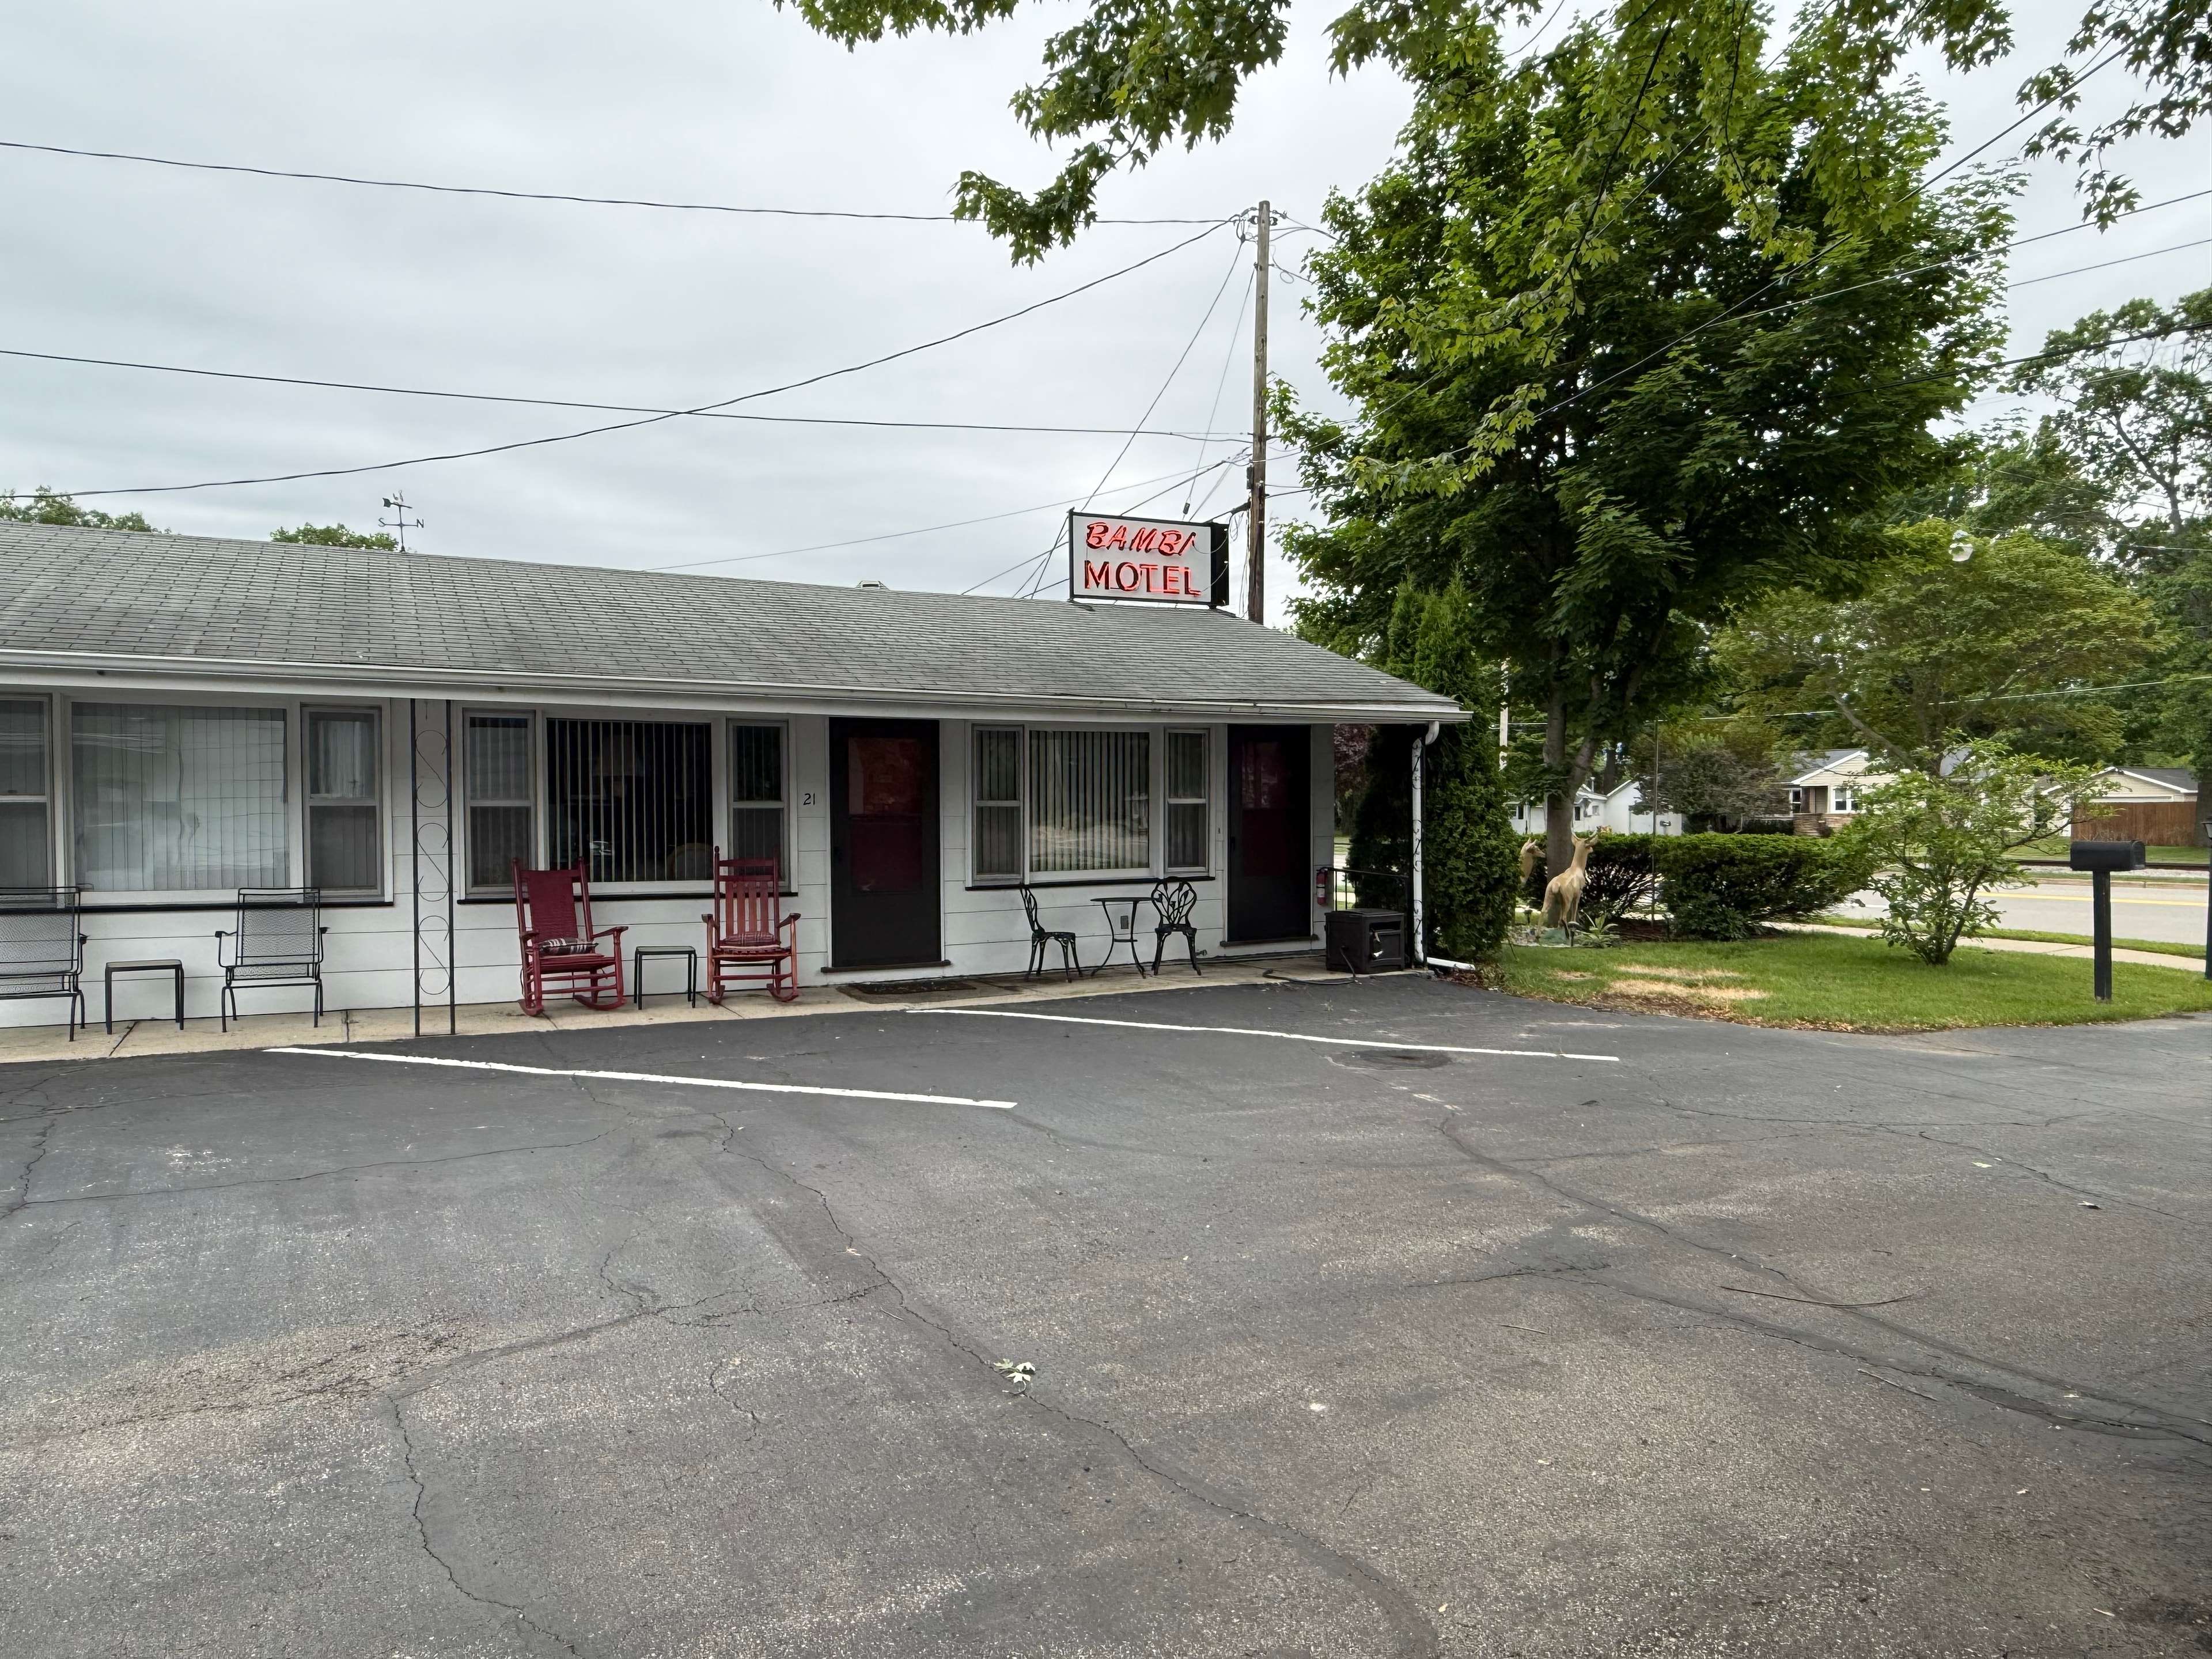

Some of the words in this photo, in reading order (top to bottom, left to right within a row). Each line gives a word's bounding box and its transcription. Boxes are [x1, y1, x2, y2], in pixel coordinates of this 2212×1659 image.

[378, 517, 386, 527] S
[416, 518, 424, 528] N
[1086, 522, 1196, 556] BAMBI
[1084, 560, 1202, 596] MOTEL
[803, 793, 815, 805] 21
